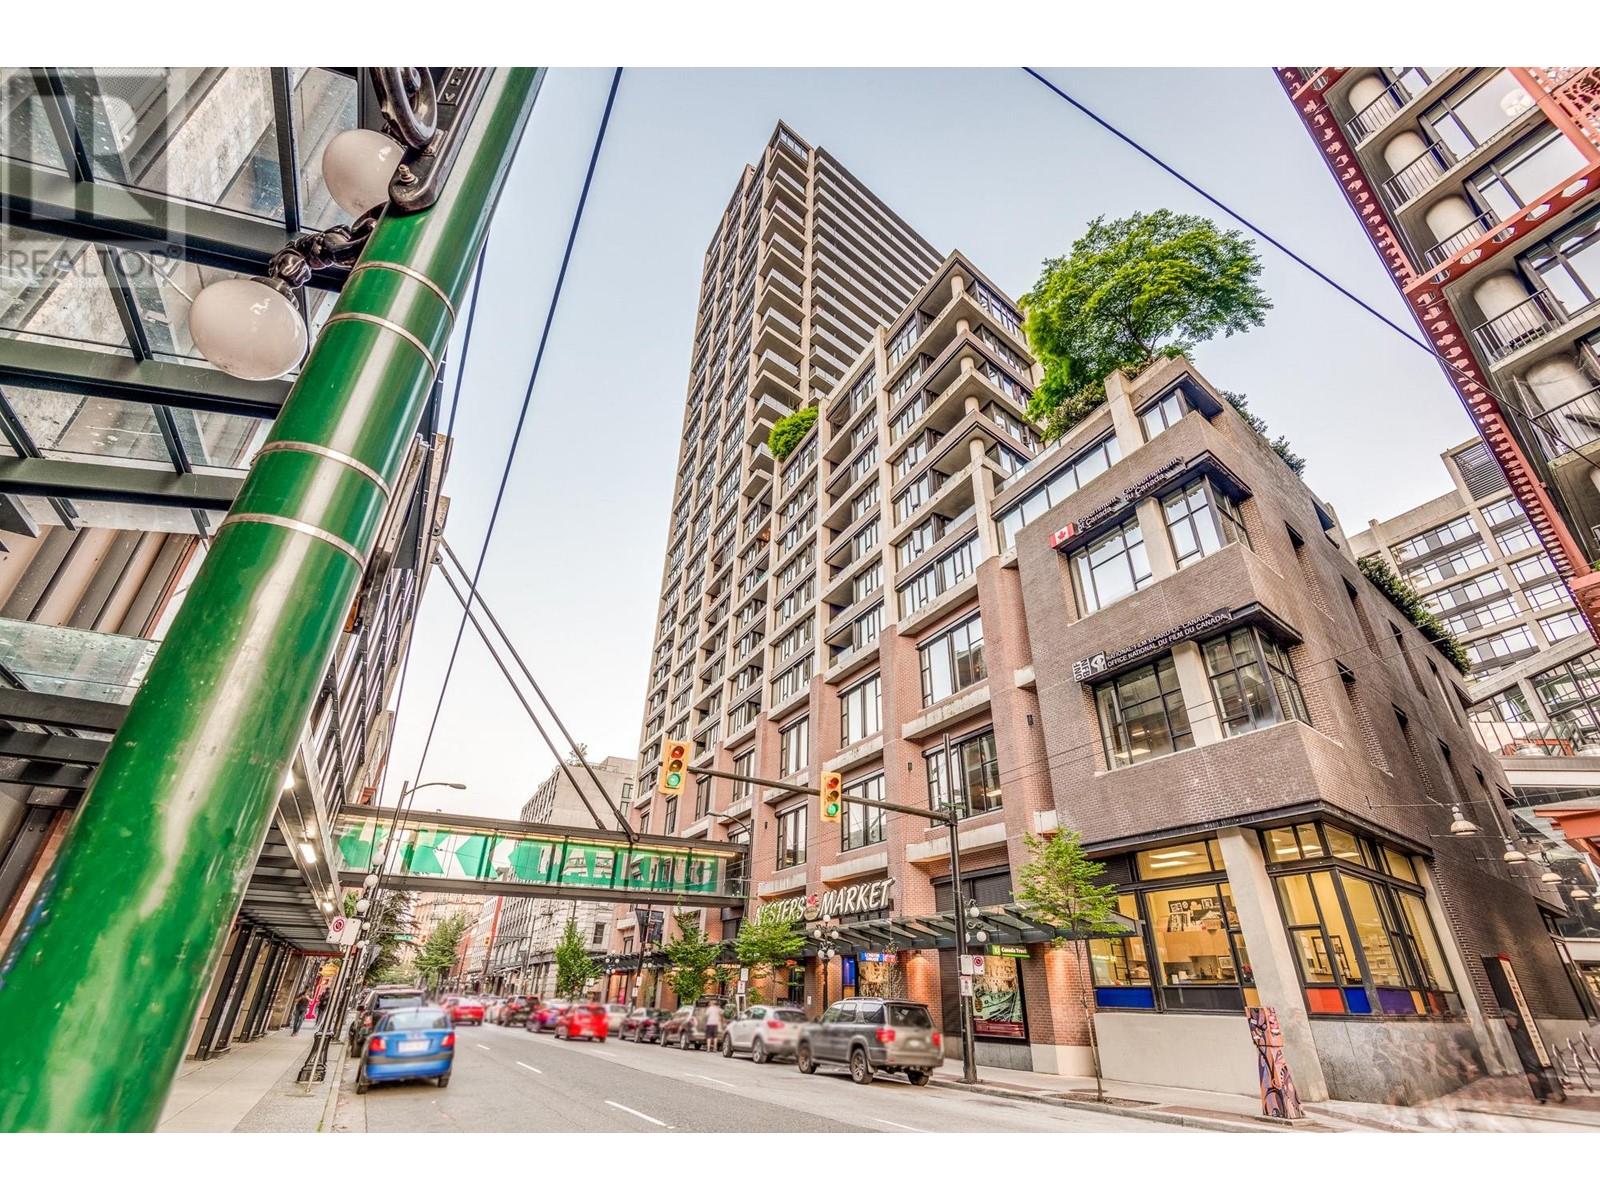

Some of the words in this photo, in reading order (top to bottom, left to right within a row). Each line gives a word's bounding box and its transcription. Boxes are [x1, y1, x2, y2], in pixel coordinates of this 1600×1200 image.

[1122, 456, 1178, 495] Gouvernement
[1135, 472, 1166, 496] Canada
[1077, 496, 1118, 524] Government
[1086, 507, 1112, 526] Canada
[1106, 646, 1133, 661] NATIONAL
[1149, 630, 1170, 642] BOARD
[1182, 612, 1212, 628] CANADA
[1107, 654, 1127, 667] OFFICE
[1127, 643, 1158, 660] NATIONAL
[1157, 637, 1168, 647] DU
[1168, 630, 1185, 642] FILM
[1184, 626, 1195, 635] DU
[1196, 613, 1228, 630] CANADA
[1073, 661, 1083, 681] ONF
[1080, 658, 1091, 678] NFB
[818, 877, 896, 918] MARKET
